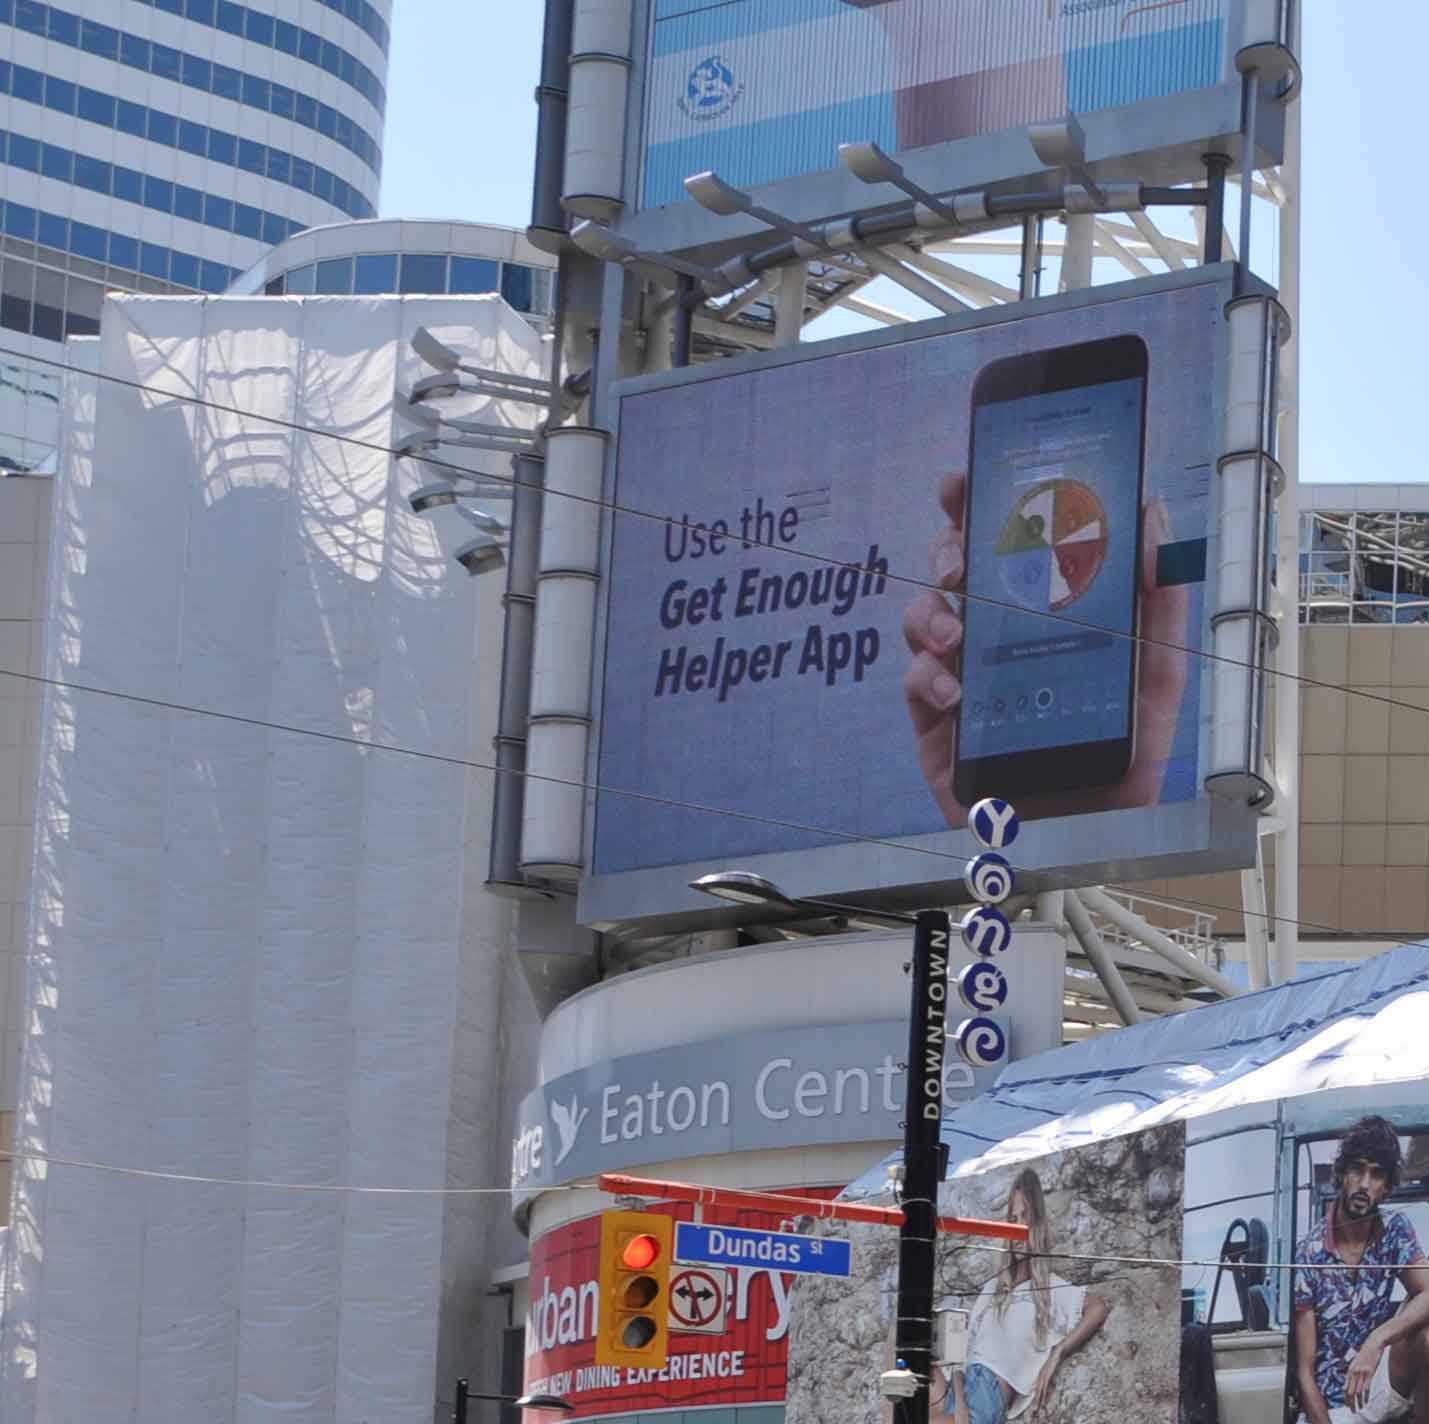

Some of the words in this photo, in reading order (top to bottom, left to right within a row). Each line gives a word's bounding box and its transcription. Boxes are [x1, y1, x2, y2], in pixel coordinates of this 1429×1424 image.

[664, 512, 728, 563] Use
[740, 498, 799, 549] the
[659, 577, 728, 630] Get
[734, 544, 889, 616] Enough
[654, 637, 792, 703] Helper
[797, 624, 880, 686] App
[958, 799, 1020, 1066] Yonge
[923, 929, 947, 1120] DOWNTOWN
[600, 1080, 731, 1144] Eaton
[754, 1054, 977, 1121] Cente
[708, 1230, 801, 1263] Dundas
[810, 1240, 824, 1256] St
[576, 1365, 621, 1392] DINING
